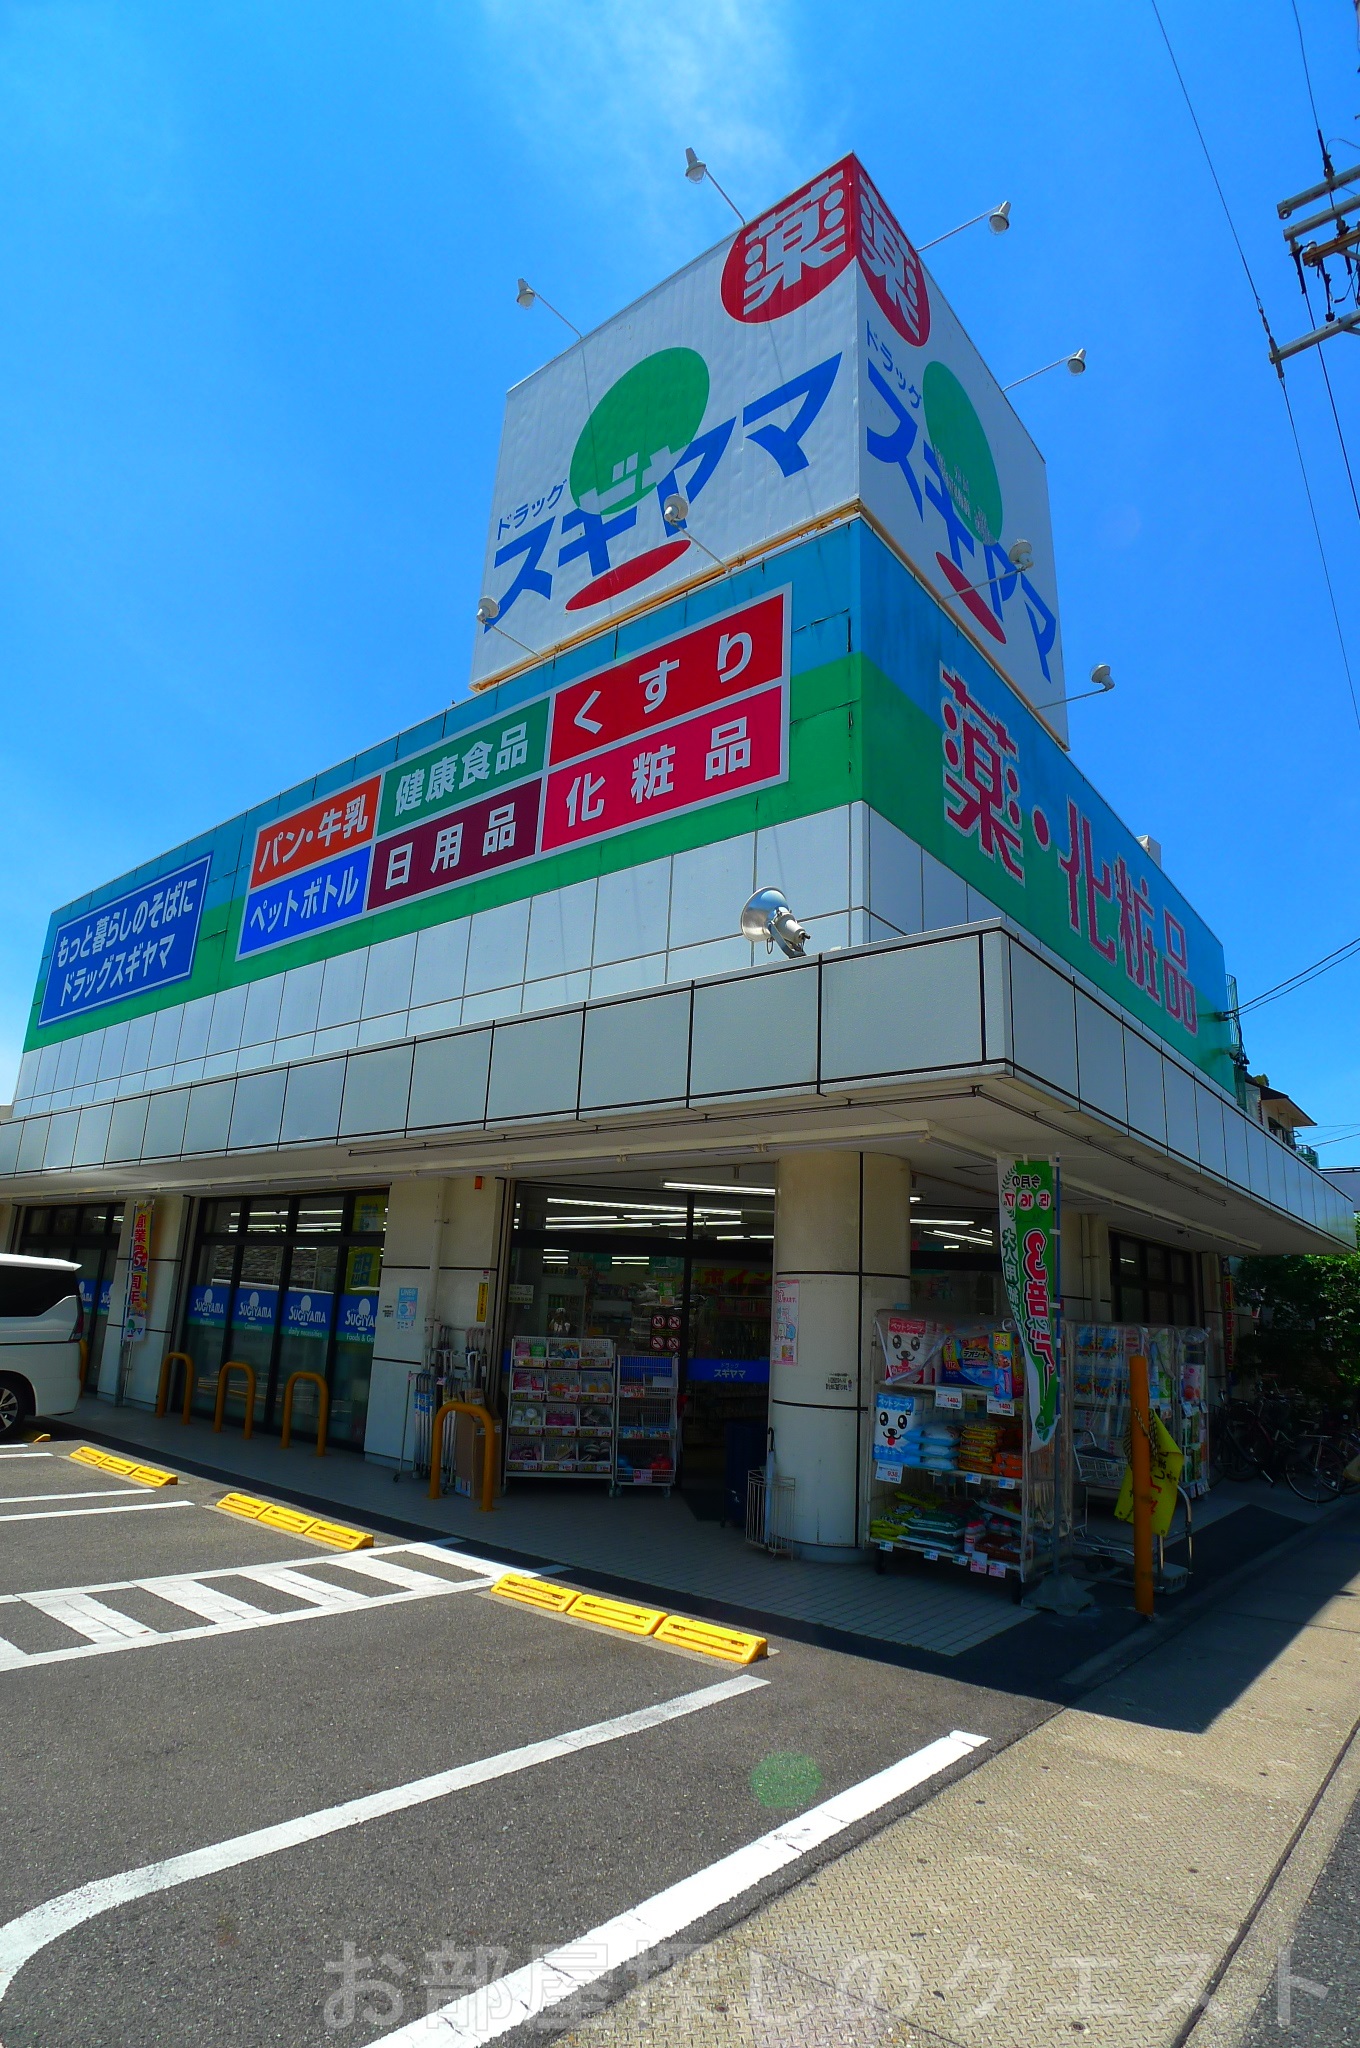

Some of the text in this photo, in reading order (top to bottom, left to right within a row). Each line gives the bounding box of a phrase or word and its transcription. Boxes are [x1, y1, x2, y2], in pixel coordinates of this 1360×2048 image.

[743, 169, 847, 316] 薬
[858, 173, 920, 341] 薬
[866, 318, 922, 410] ドラッグ
[484, 350, 844, 634] スギヤマ
[497, 478, 569, 542] ドラッグ
[866, 358, 1056, 685] スギヤマ
[573, 629, 753, 735] くすり
[392, 720, 530, 818] 健康食品
[564, 716, 752, 829] 化粧品
[258, 791, 371, 873] パン・牛乳
[386, 801, 517, 888] 日用品
[940, 661, 1200, 1037] 薬・化粧品
[57, 877, 198, 969] もっと暮らしのそばに
[249, 865, 359, 934] ペットボトル
[60, 932, 176, 1008] ドラッグスギヤマ
[194, 1297, 225, 1315] SUGIYAMA
[238, 1301, 272, 1319] SUGIYAMA
[288, 1304, 327, 1324] SUGIYAMA
[288, 1326, 300, 1337] daily
[344, 1308, 376, 1328] SUGIYA
[346, 1332, 360, 1342] Foods
[713, 1368, 747, 1379] スギヤマ
[877, 1398, 912, 1410] ペットシーツ
